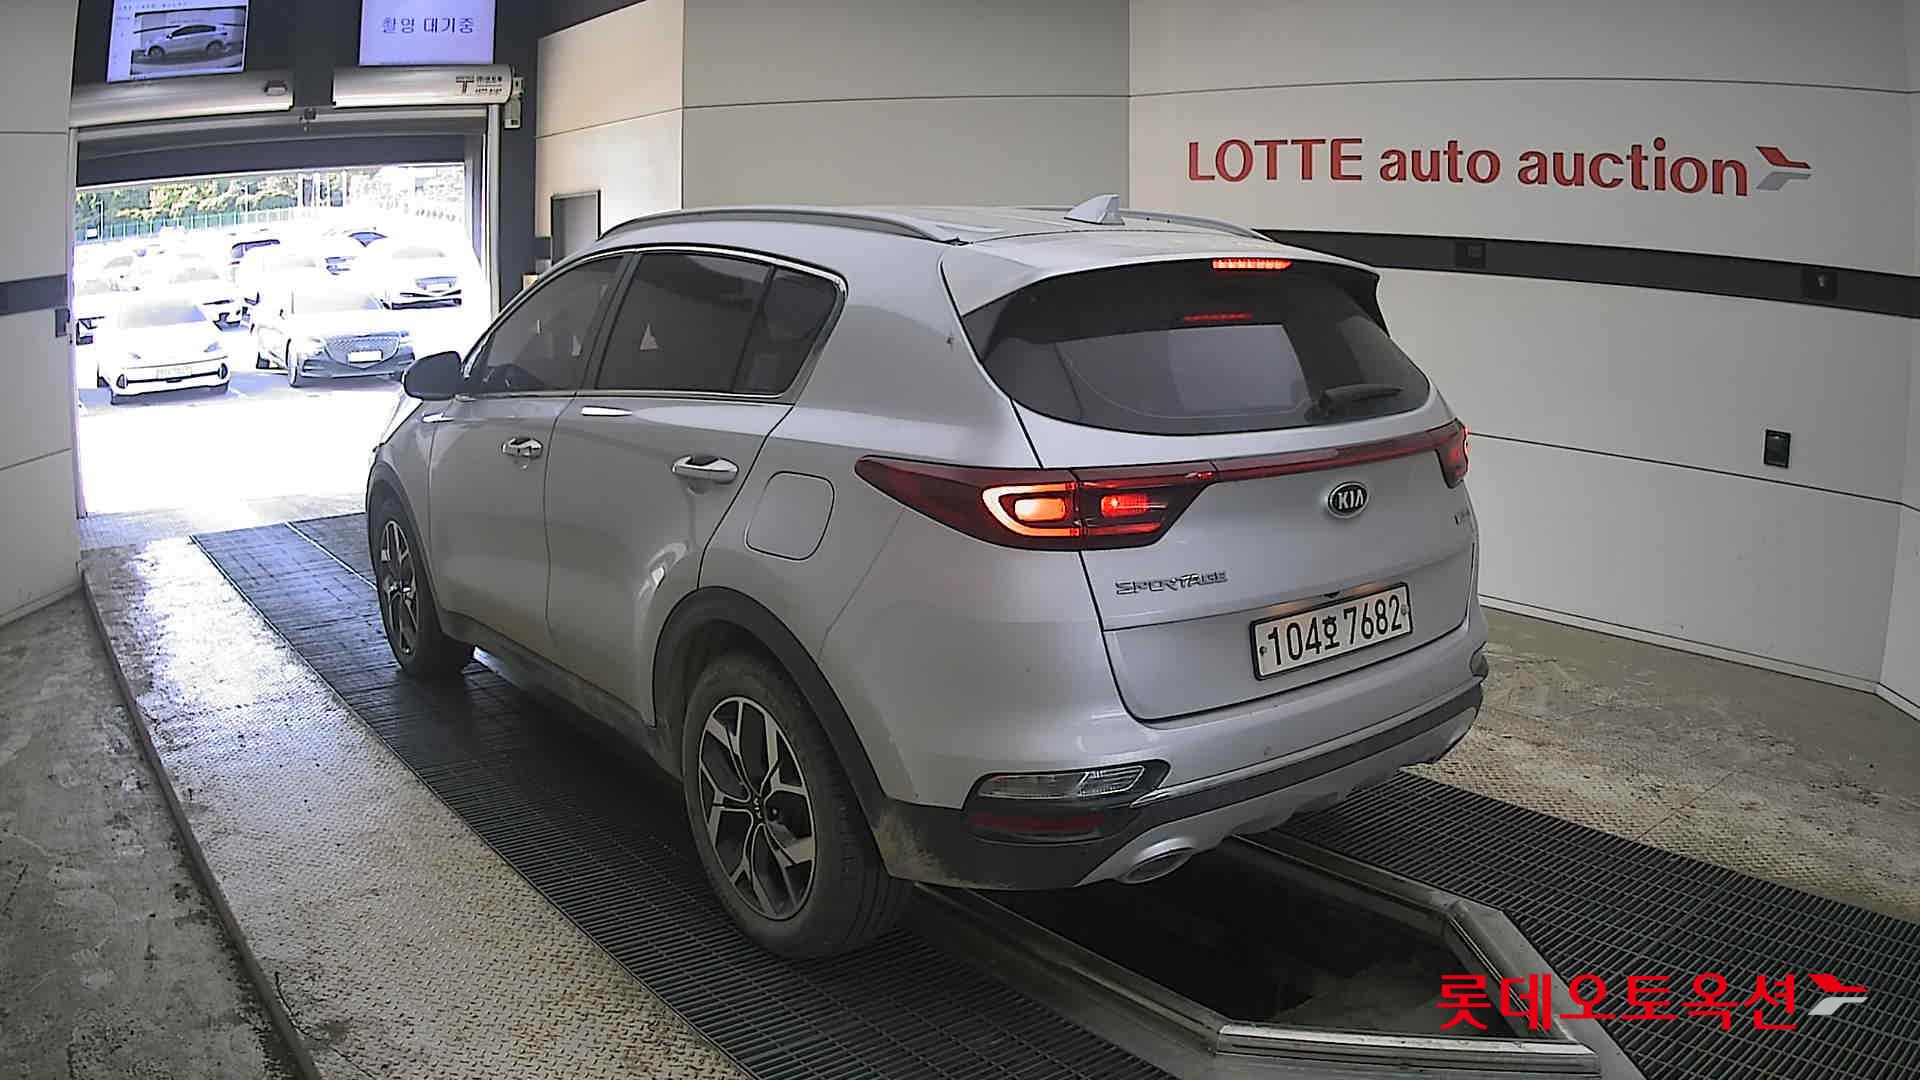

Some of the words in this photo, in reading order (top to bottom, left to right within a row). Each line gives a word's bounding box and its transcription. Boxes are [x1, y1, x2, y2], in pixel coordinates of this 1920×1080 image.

[423, 17, 475, 33] 대기중
[1188, 138, 1363, 183] LOTTE
[1379, 140, 1501, 184] auto
[1518, 137, 1748, 196] auction
[1337, 489, 1364, 510] KIA
[1115, 571, 1228, 595] SPORTAGE
